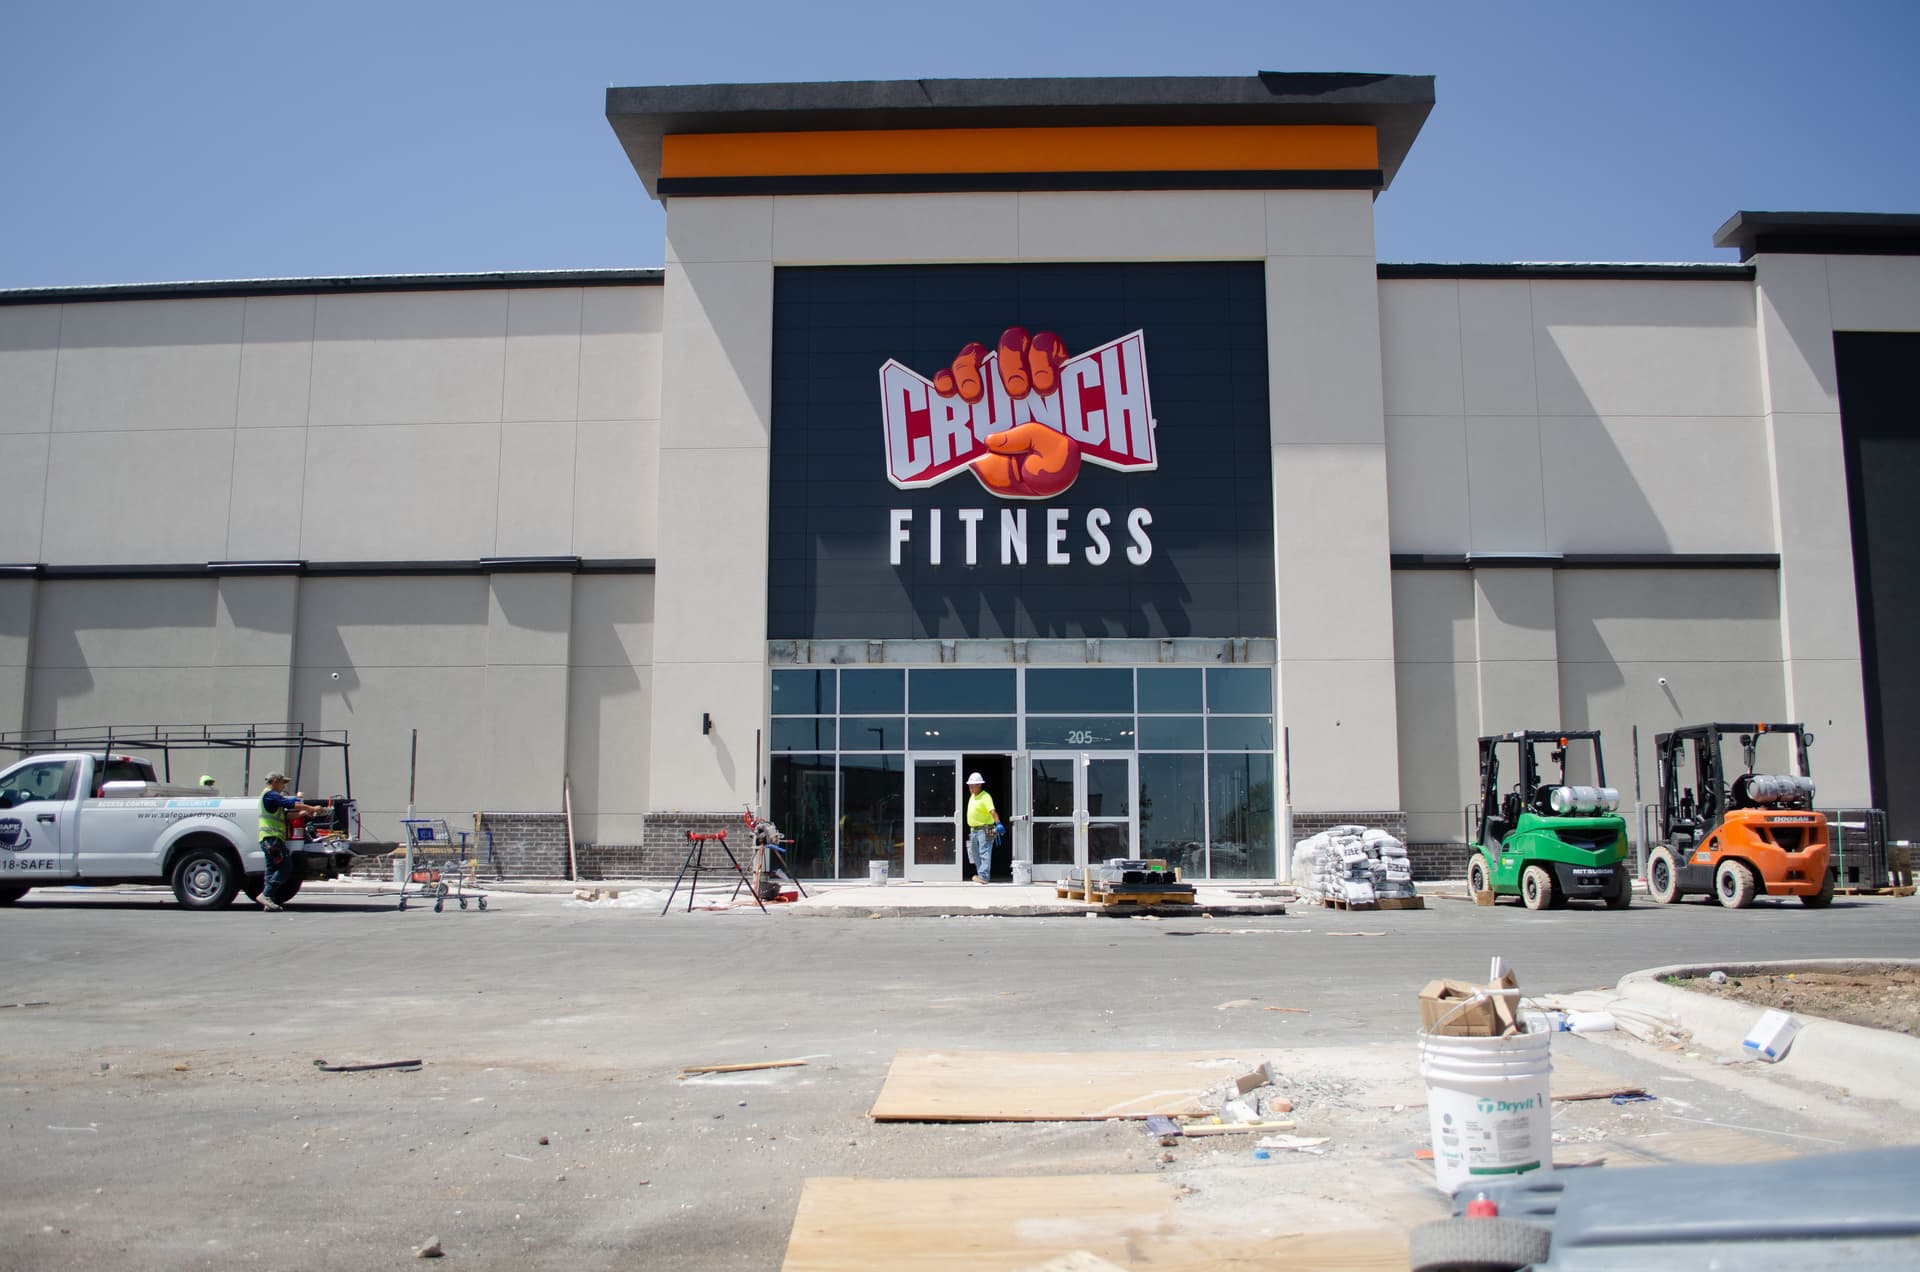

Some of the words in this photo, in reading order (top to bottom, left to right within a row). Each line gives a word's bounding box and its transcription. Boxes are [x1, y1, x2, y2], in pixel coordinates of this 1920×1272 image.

[884, 333, 1153, 482] CRUNCH
[890, 507, 1153, 566] FITNESS
[1068, 730, 1092, 744] 205
[2, 859, 54, 870] 18-SAFE
[1497, 1098, 1534, 1114] Dryvit
